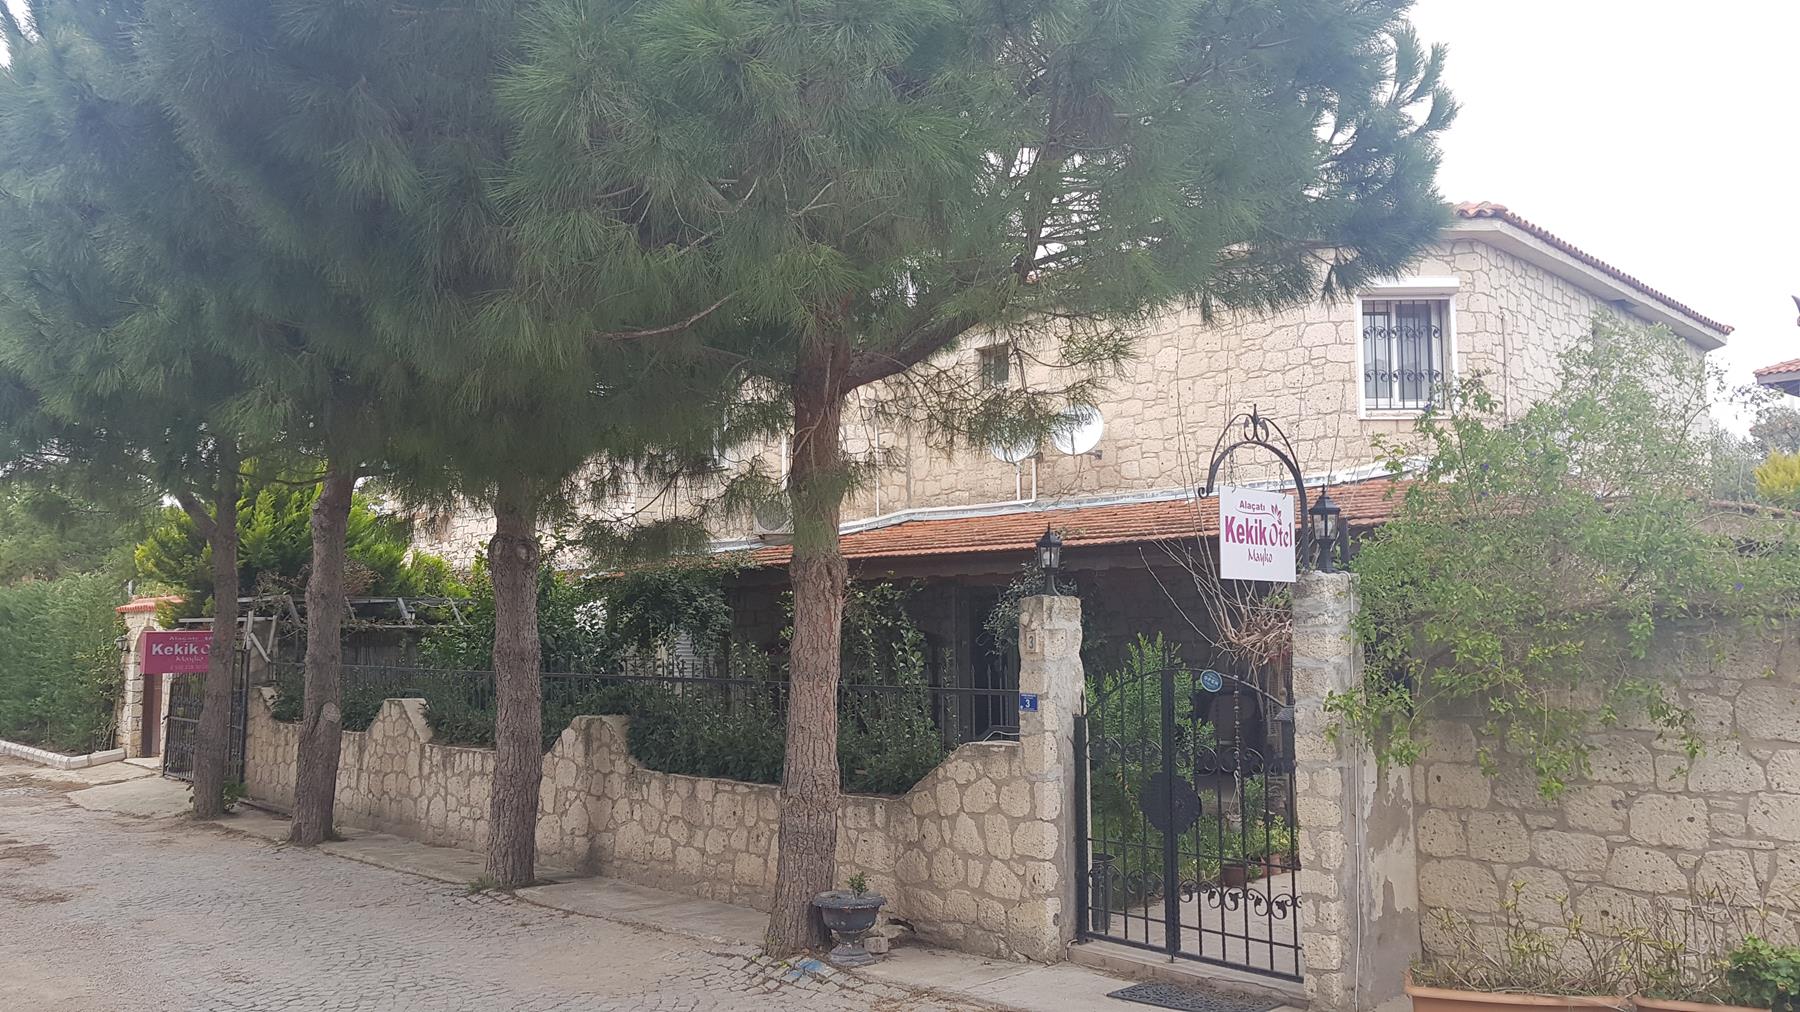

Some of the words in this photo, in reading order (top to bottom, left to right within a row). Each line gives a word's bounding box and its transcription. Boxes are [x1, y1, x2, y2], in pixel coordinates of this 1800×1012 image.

[1239, 500, 1265, 512] Alaçatı
[1225, 515, 1268, 546] Kekik
[1269, 522, 1293, 548] Otel
[1028, 635, 1034, 649] 3
[151, 643, 198, 655] Kekik
[1025, 699, 1031, 708] 3
